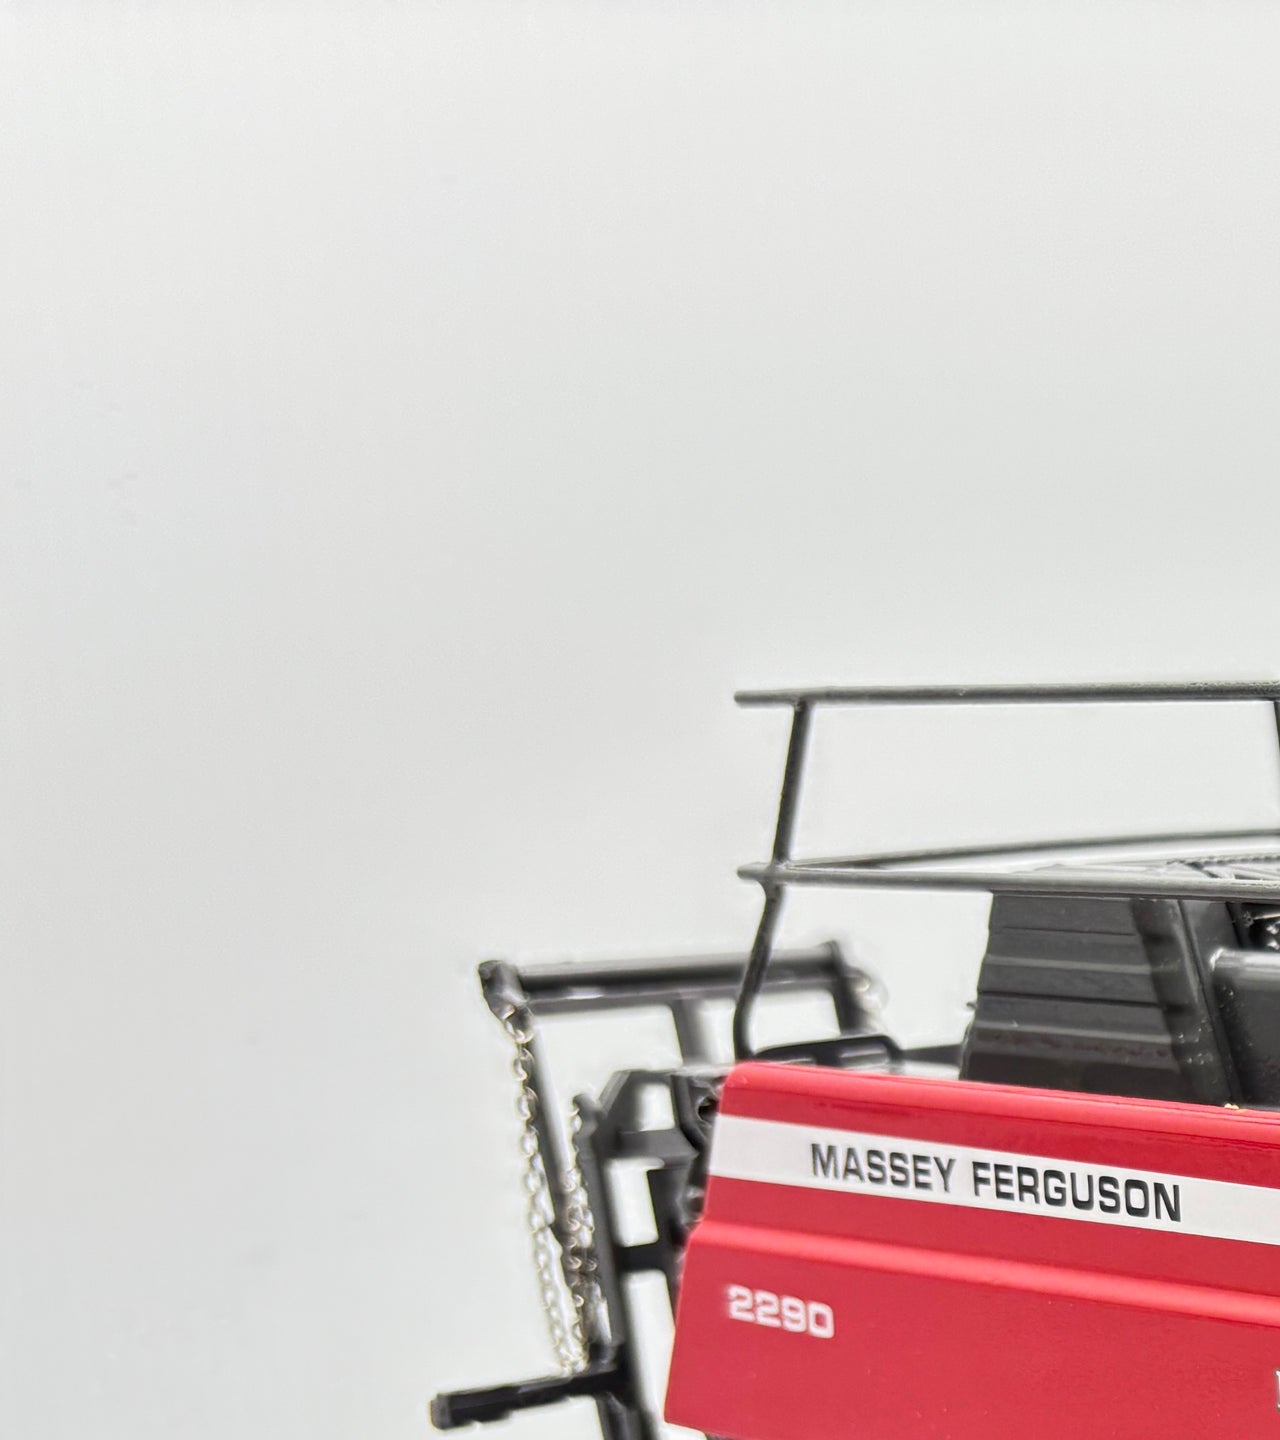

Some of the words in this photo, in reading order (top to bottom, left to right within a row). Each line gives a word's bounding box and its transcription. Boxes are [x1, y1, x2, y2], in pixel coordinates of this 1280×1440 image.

[811, 1142, 956, 1193] MASSEY
[972, 1160, 1182, 1222] FERGUSON
[727, 1284, 835, 1339] 2290
